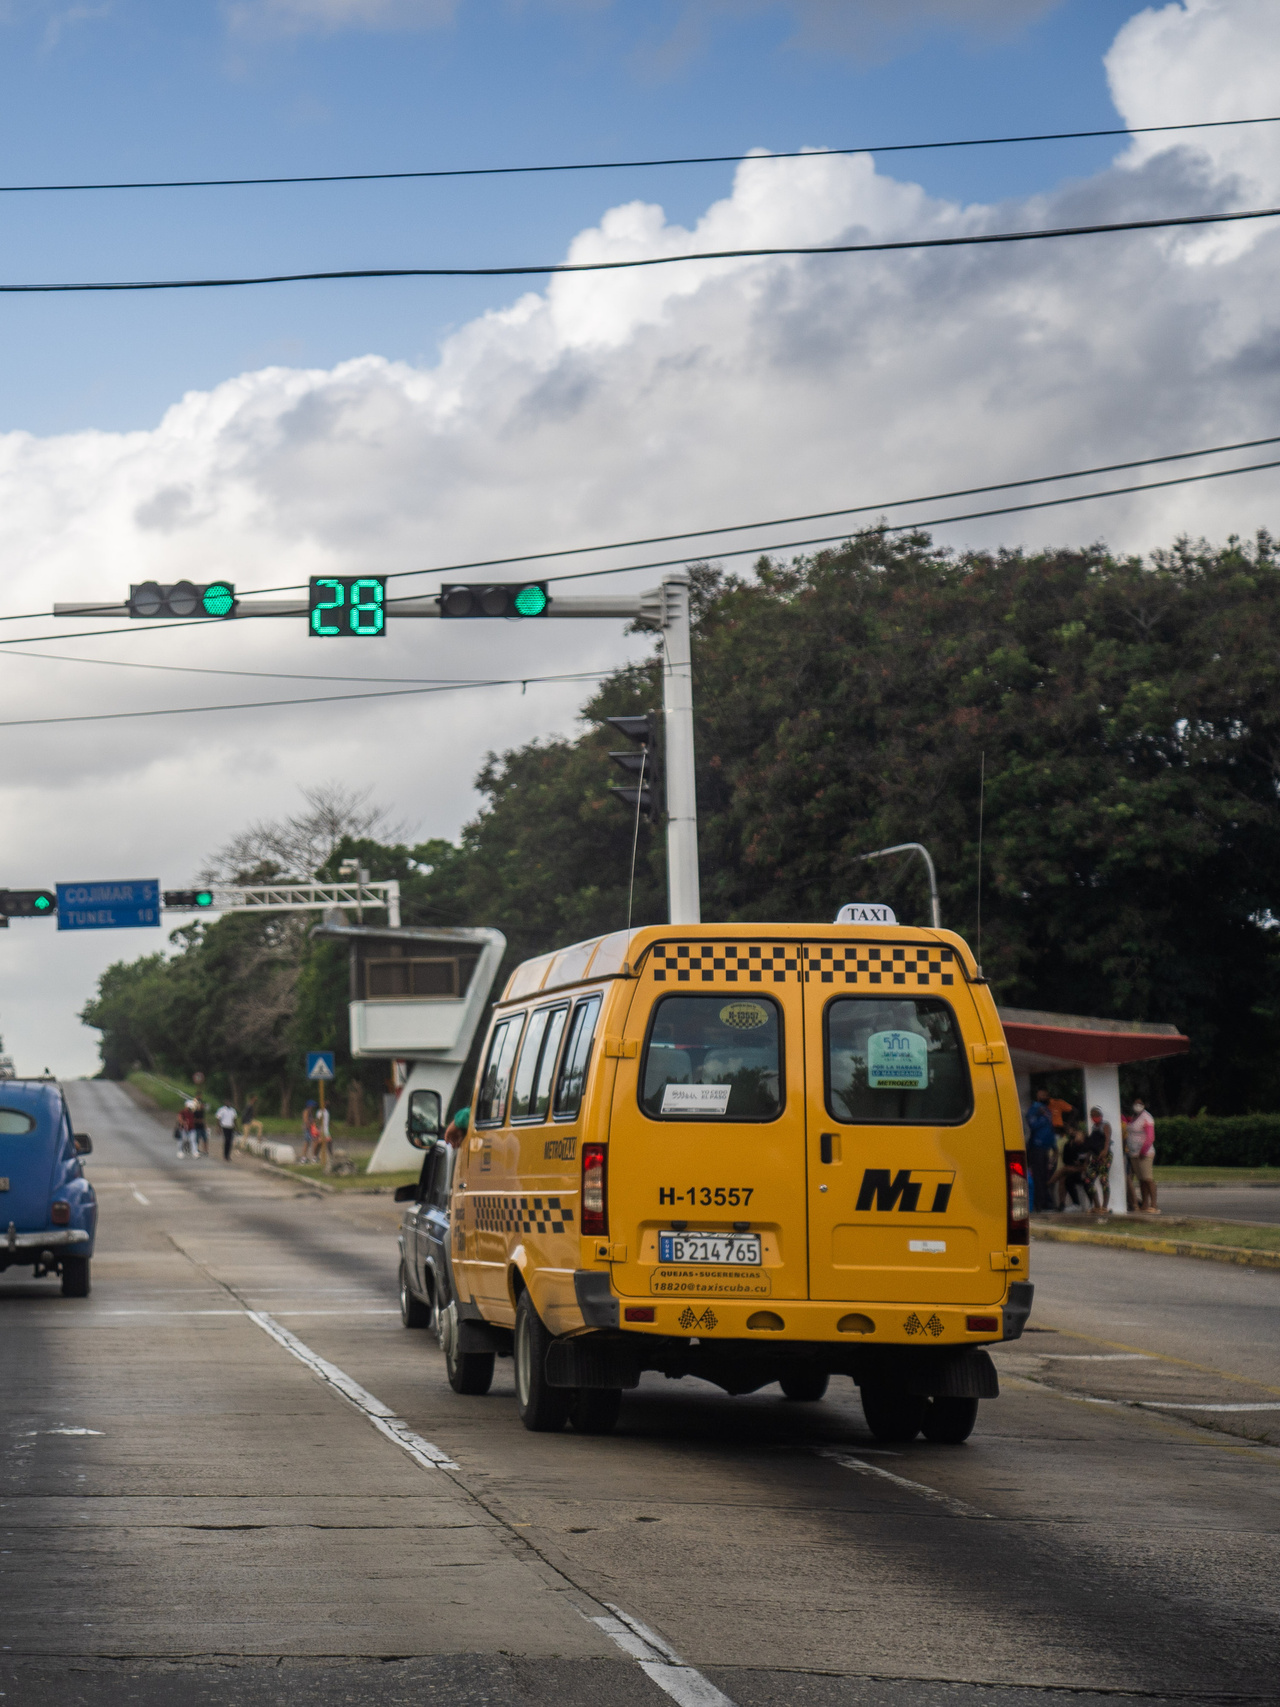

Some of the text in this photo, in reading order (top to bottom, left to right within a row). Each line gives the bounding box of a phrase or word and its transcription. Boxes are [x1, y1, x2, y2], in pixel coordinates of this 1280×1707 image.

[311, 579, 384, 635] 28
[142, 885, 153, 901] 5
[137, 908, 154, 922] 10
[847, 908, 888, 921] TAXI
[659, 1187, 755, 1206] H-13557
[653, 1282, 768, 1293] 18820@taxiscuba.cu
